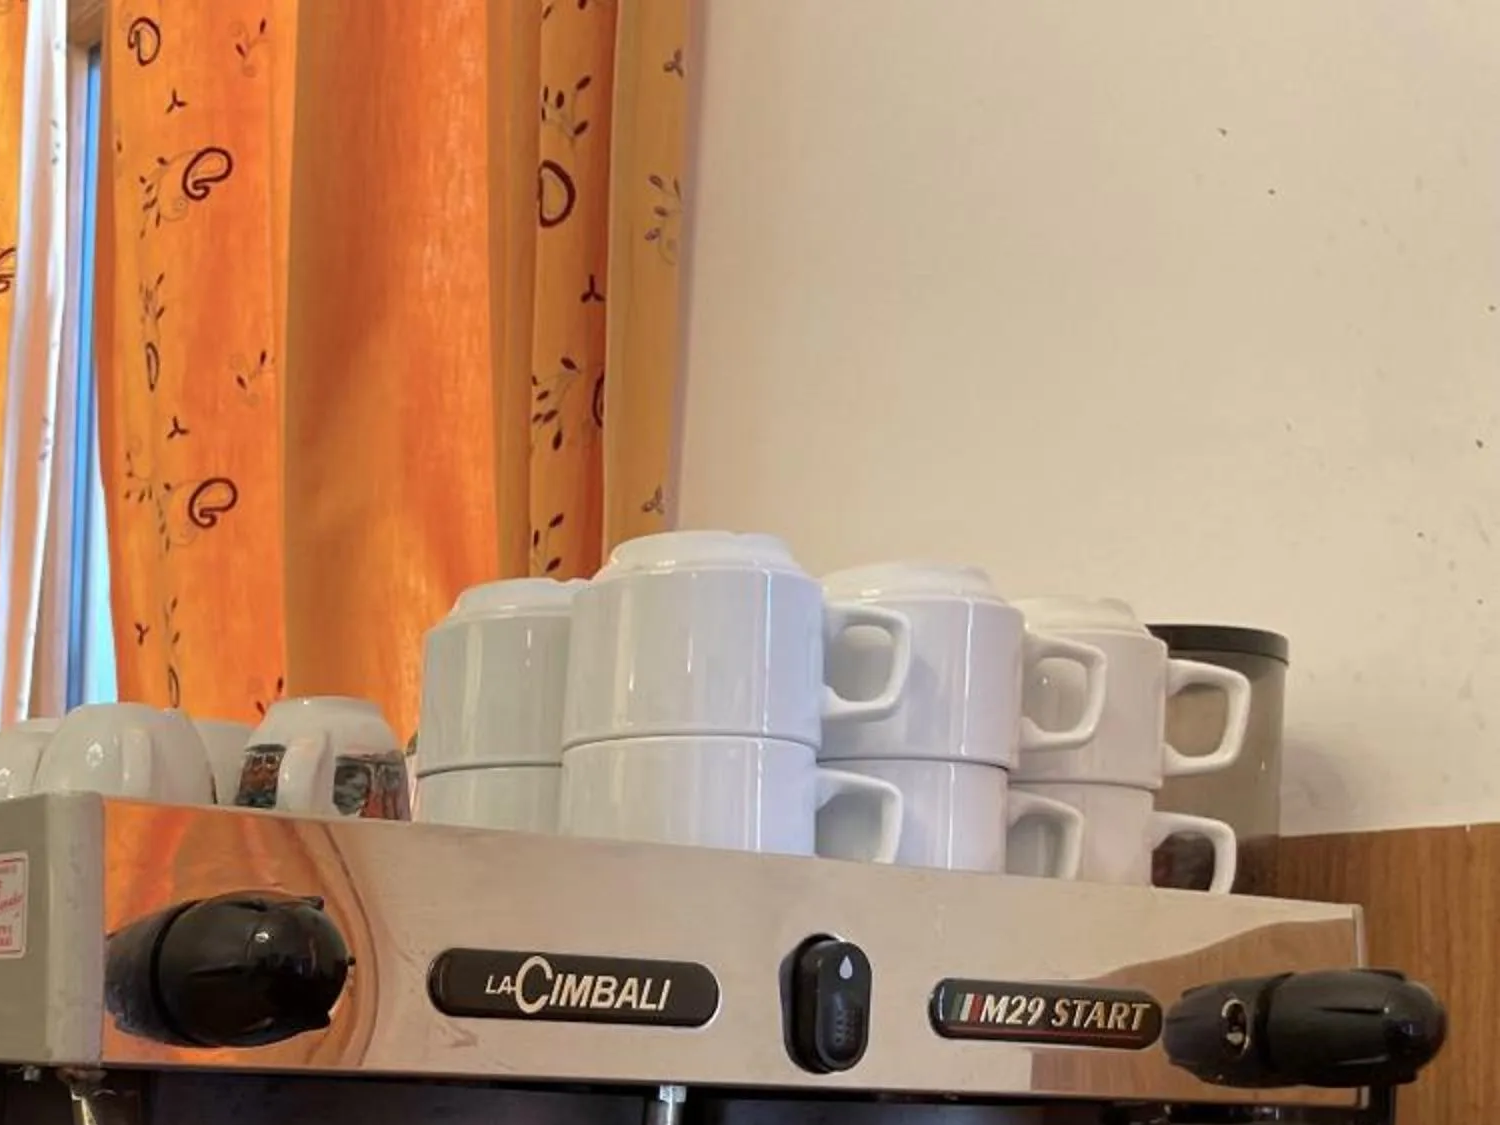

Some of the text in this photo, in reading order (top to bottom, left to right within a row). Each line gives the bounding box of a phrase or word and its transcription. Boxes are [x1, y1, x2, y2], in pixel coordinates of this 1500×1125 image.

[485, 955, 671, 1014] LA CIMBALI
[980, 991, 1151, 1032] M29 START
